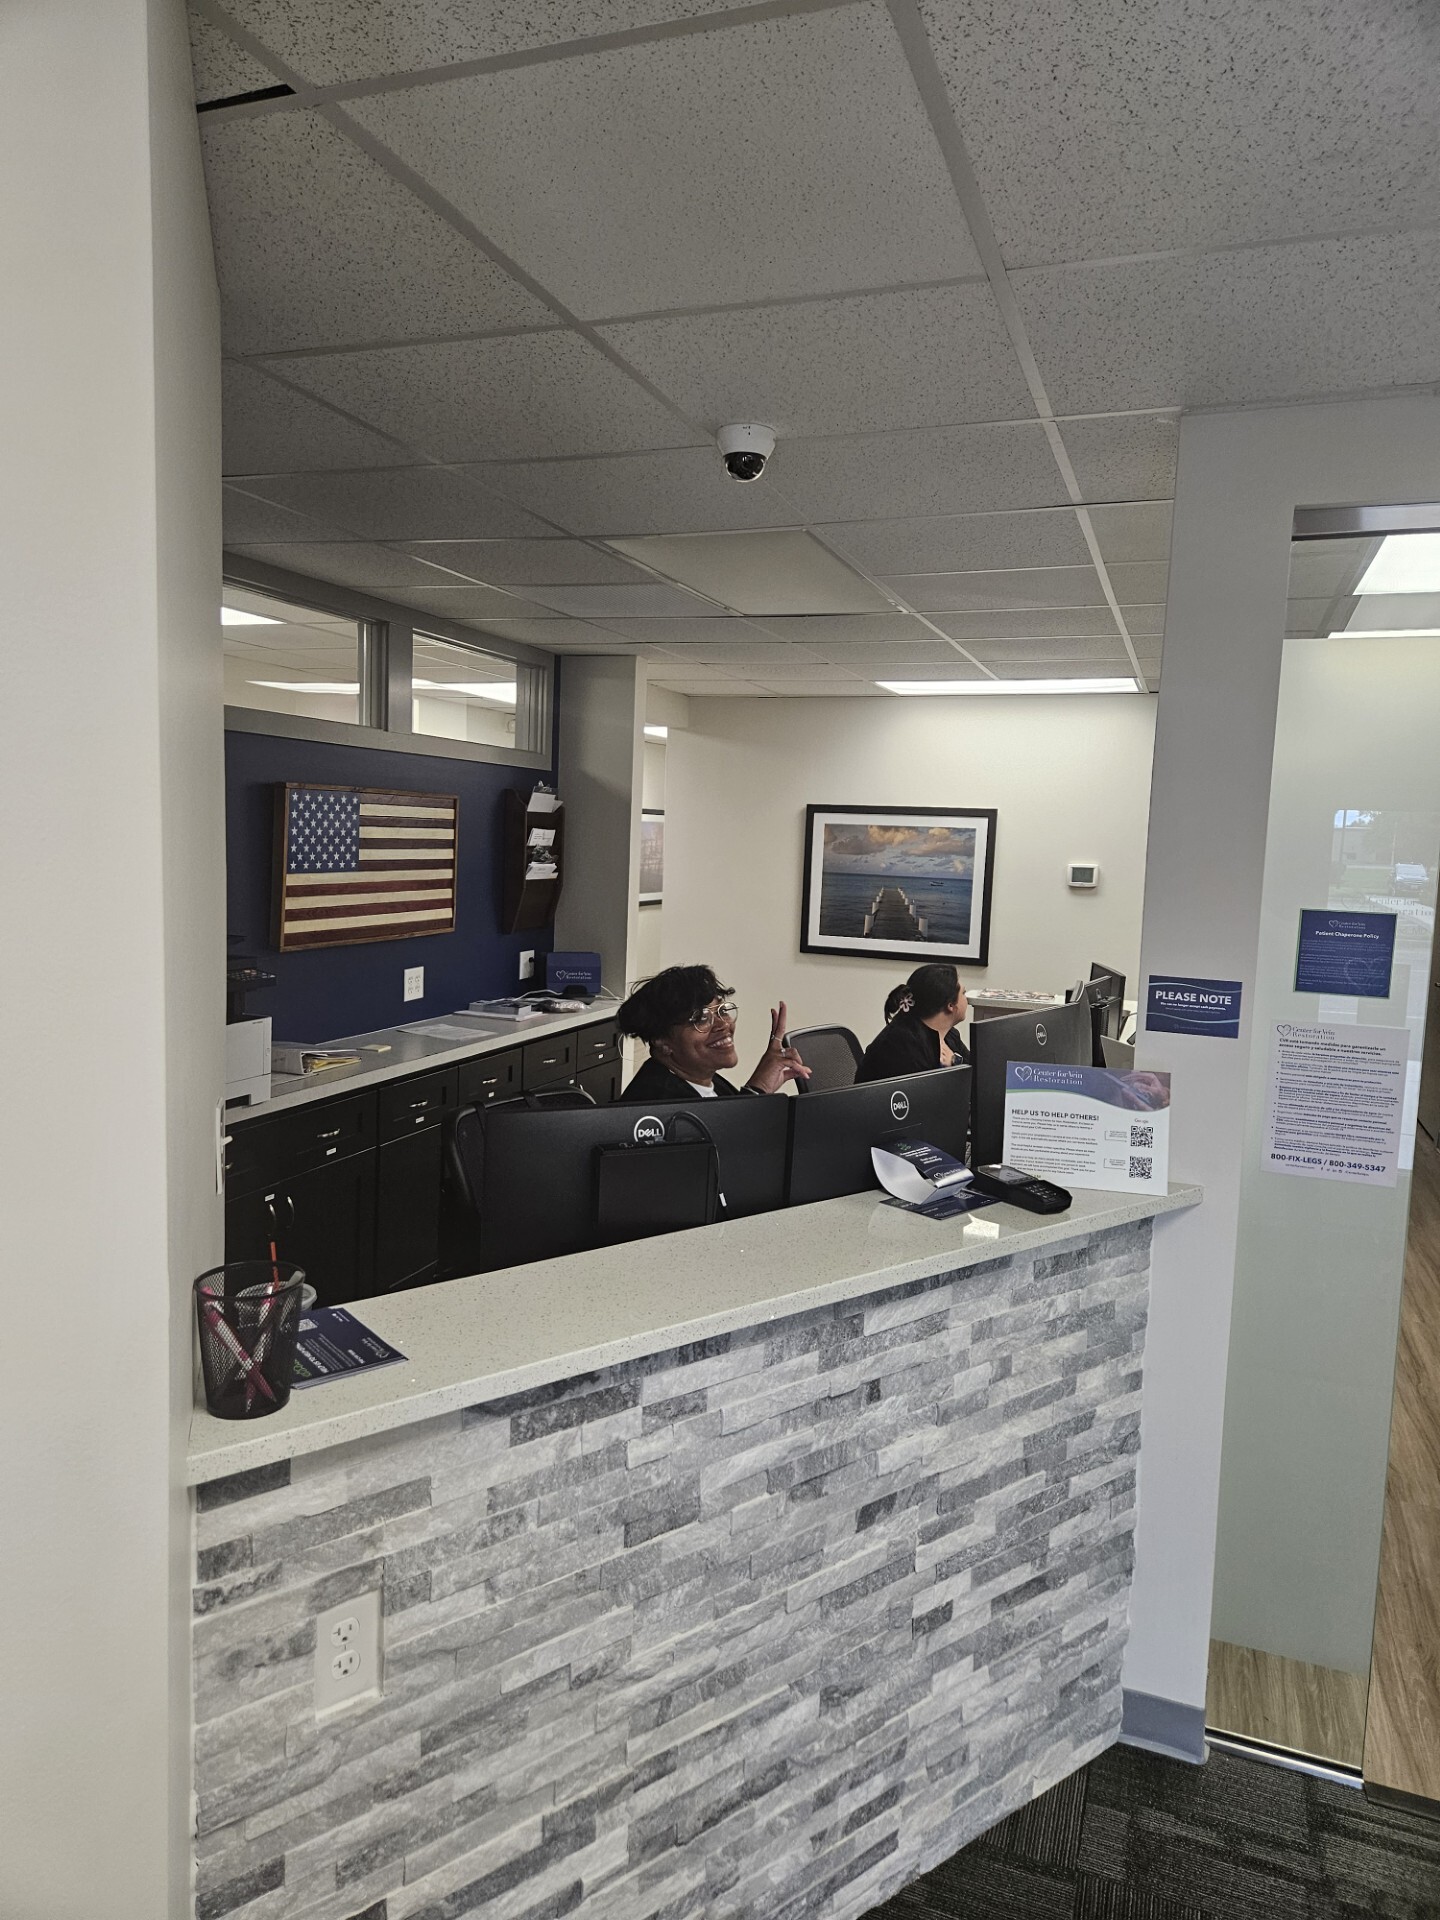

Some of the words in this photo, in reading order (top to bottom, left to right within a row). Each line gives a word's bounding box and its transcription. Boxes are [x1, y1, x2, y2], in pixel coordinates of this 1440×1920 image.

[1155, 990, 1197, 1002] PLEASE
[1199, 993, 1232, 1005] NOTE
[1292, 1032, 1335, 1040] Restoration
[1033, 1068, 1056, 1076] Center
[1068, 1070, 1083, 1079] Vein
[1033, 1075, 1083, 1085] Restoration
[893, 1100, 908, 1111] DELL
[1069, 1113, 1099, 1121] OTHERS!
[638, 1128, 661, 1138] DELL
[1270, 1153, 1322, 1165] 800-FIX-LEGS
[1329, 1159, 1386, 1173] 800-349-5347
